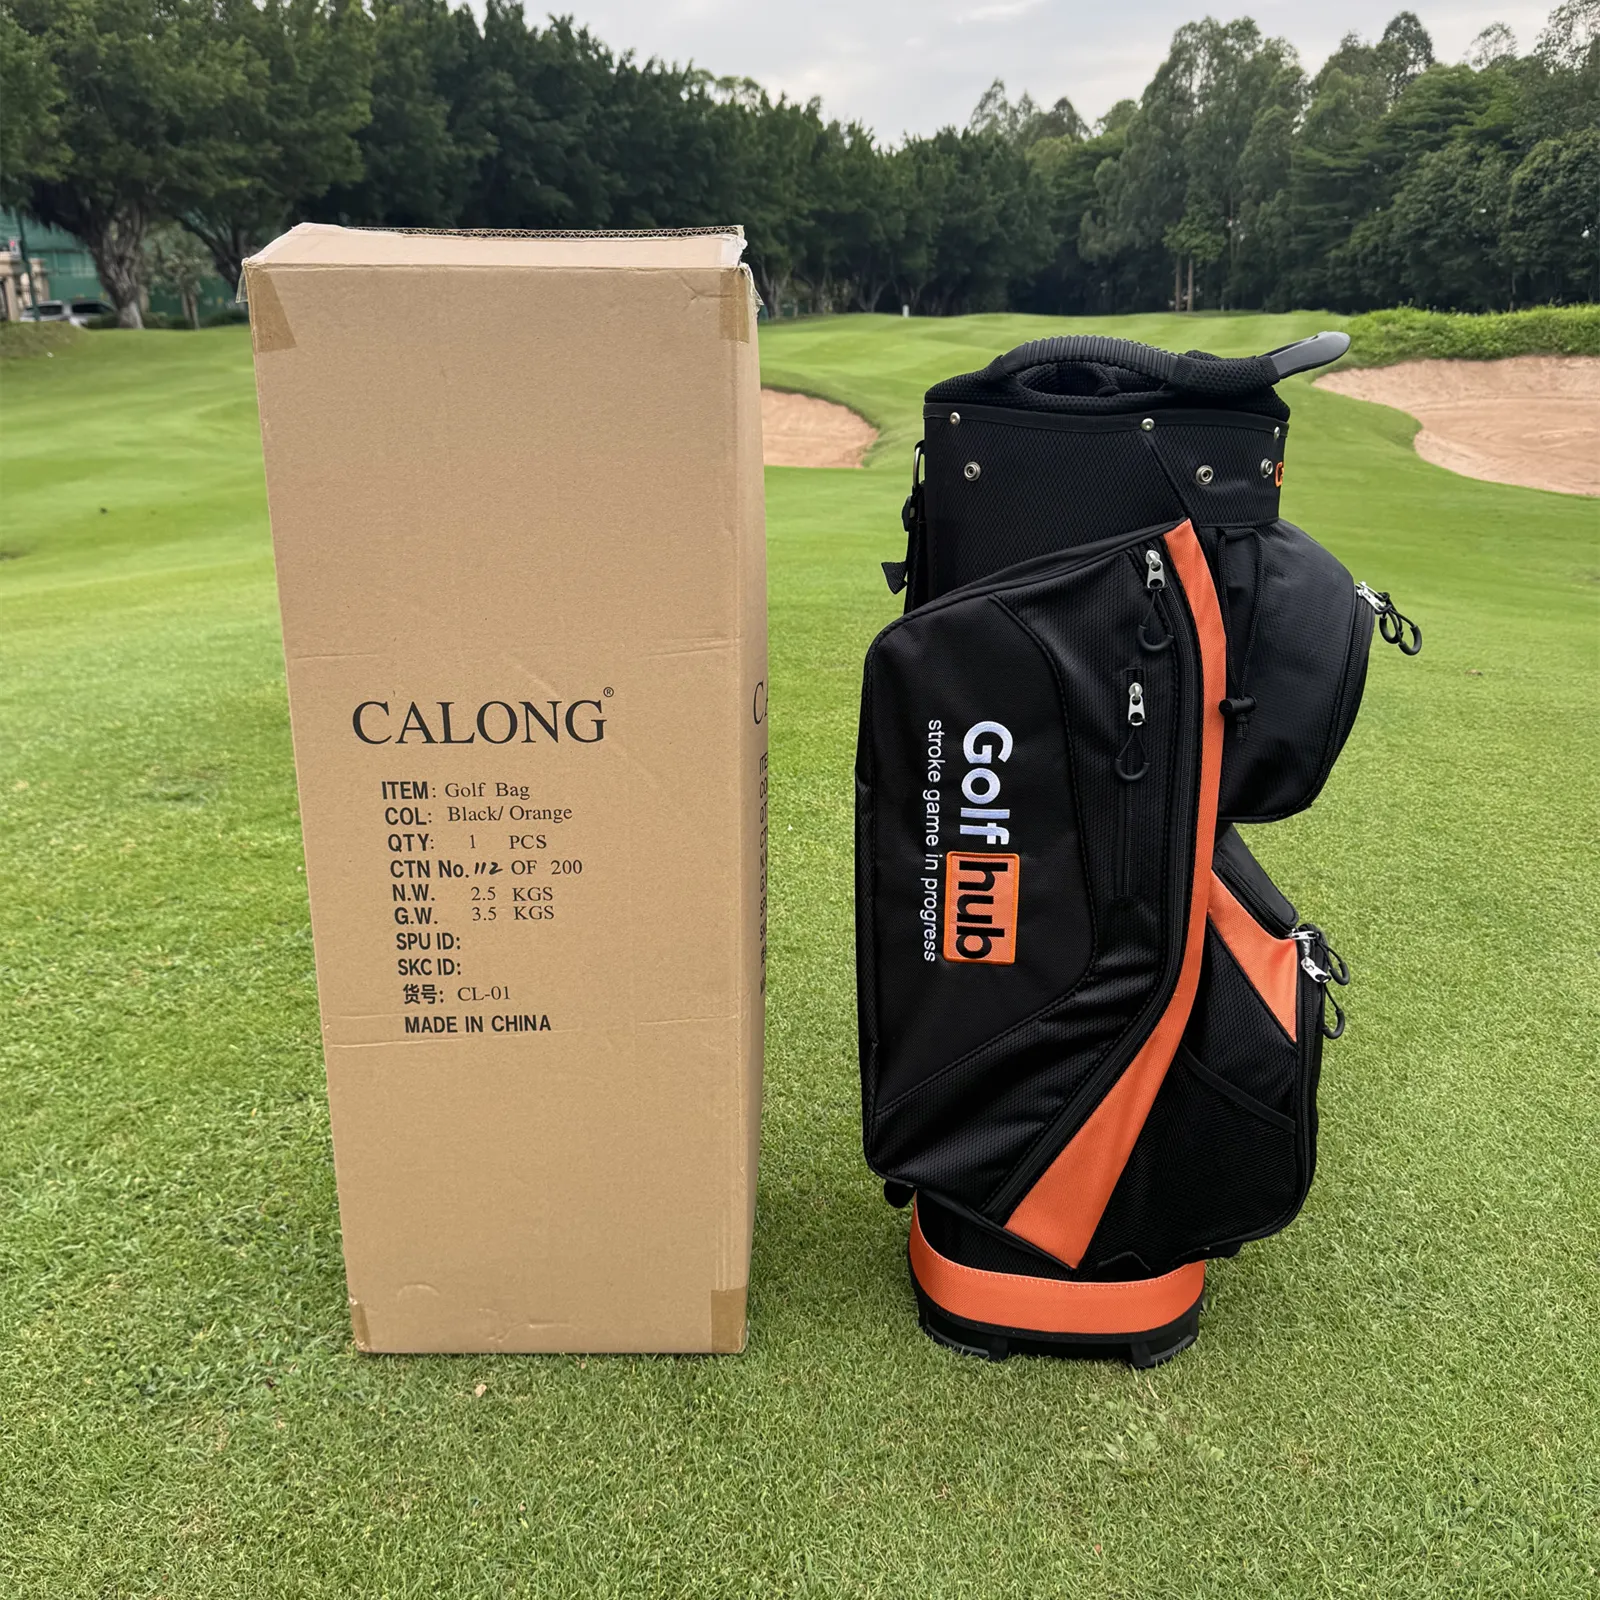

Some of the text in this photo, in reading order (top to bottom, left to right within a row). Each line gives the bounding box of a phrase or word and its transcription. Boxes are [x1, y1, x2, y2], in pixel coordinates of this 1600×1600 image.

[381, 781, 531, 800] ITEM: Golf Bag
[384, 807, 433, 825] COL:
[509, 806, 573, 823] Orange
[387, 834, 435, 852] QTY:
[509, 835, 547, 849] PCS
[919, 720, 946, 961] stroke game in progress
[955, 721, 1014, 959] Golf hub
[389, 860, 431, 878] CTN
[510, 860, 538, 875] OF
[550, 860, 583, 875] 200
[391, 884, 554, 901] N.W. 2.5 KGS
[394, 906, 555, 925] G.W. 3.5 KGS
[395, 933, 461, 950] SPU ID:
[397, 958, 462, 975] SKC ID:
[457, 986, 510, 1001] CL-01
[404, 1015, 552, 1033] MADE IN CHINA
